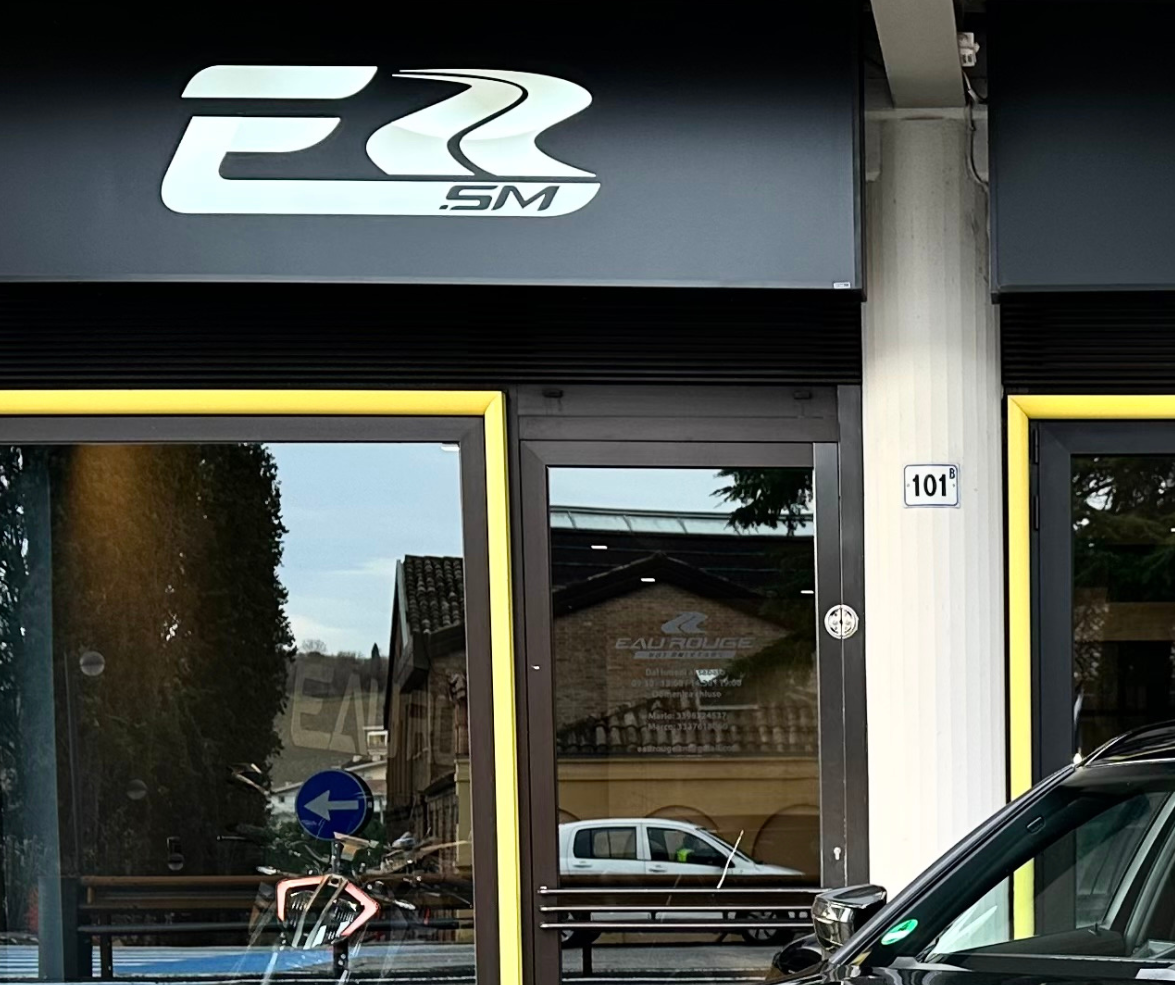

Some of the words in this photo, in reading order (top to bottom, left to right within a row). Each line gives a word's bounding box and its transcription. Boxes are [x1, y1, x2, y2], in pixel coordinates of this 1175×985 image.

[912, 474, 947, 497] 101
[615, 637, 665, 649] EAU
[668, 636, 757, 649] ROUGE
